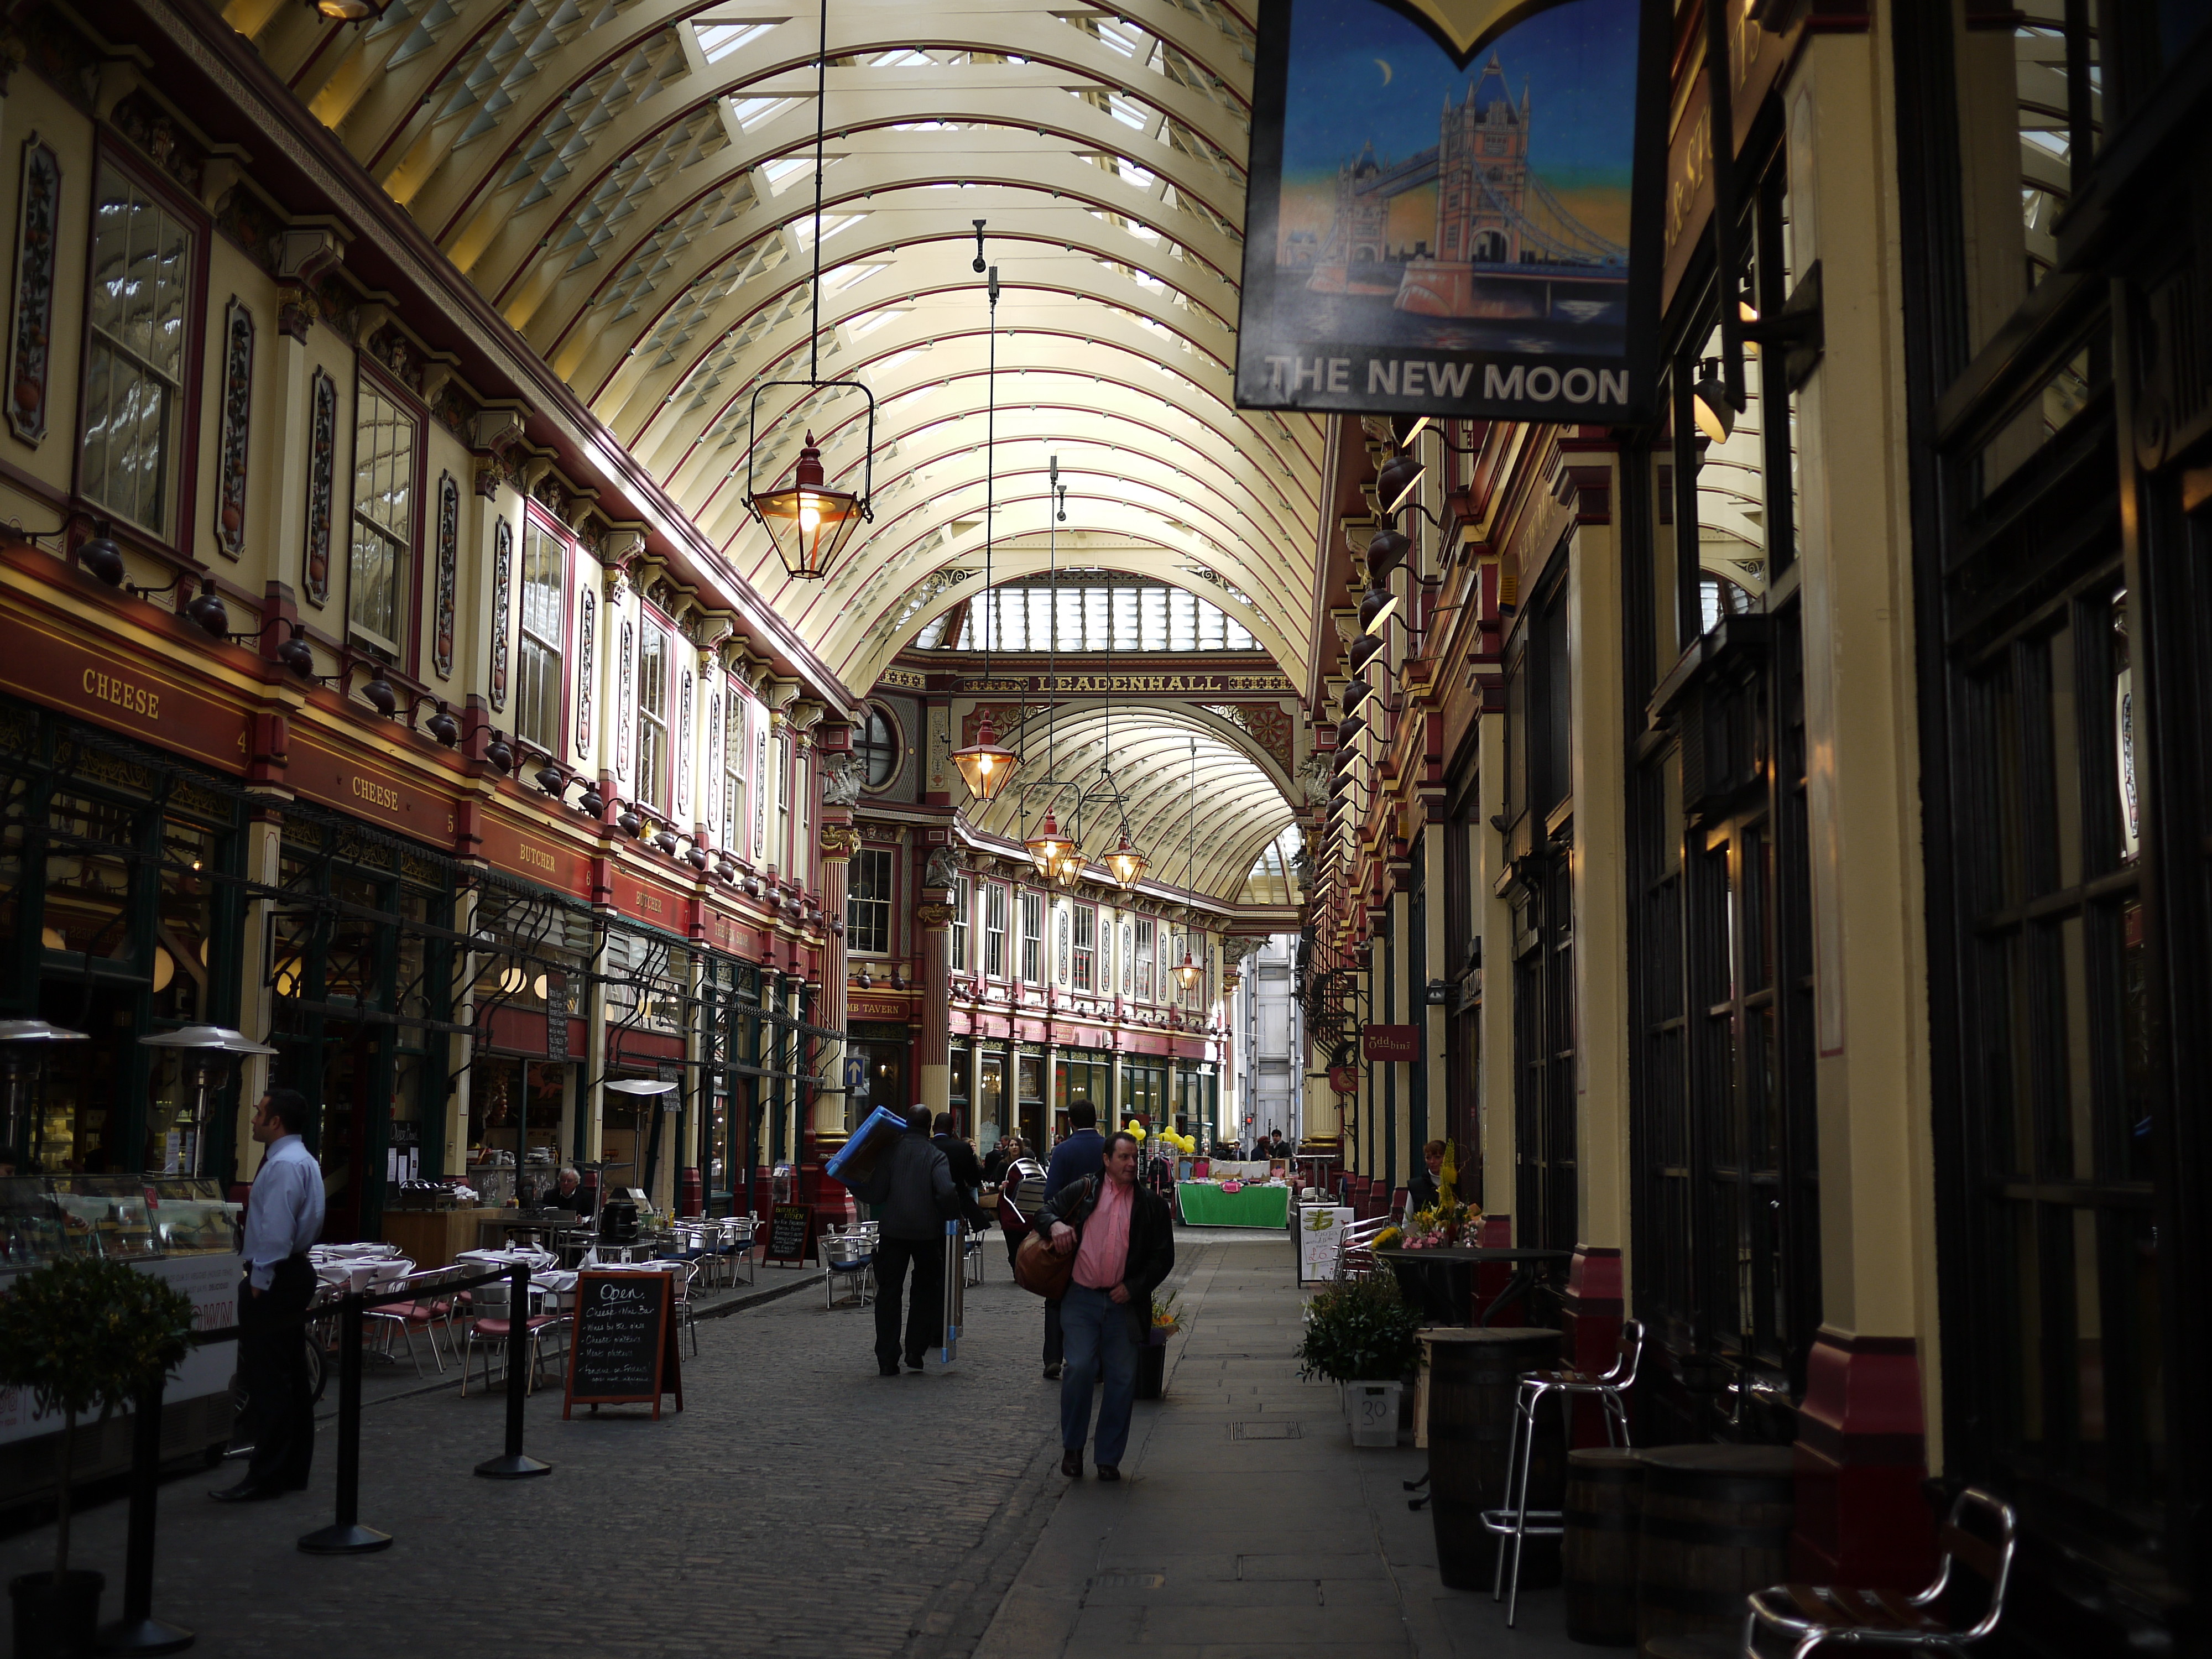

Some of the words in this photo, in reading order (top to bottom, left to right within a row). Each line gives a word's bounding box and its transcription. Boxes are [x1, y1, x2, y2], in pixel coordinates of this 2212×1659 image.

[1265, 355, 1350, 393] THE
[1367, 359, 1474, 398] NEW
[1484, 364, 1629, 405] MOON
[83, 668, 159, 719] CHEESE
[1037, 676, 1222, 691] LEADENHALL
[237, 731, 247, 754] 4
[353, 776, 399, 812] CHEESE
[448, 814, 454, 833] 5
[520, 843, 555, 873] BUTCHER
[586, 870, 591, 886] 6
[636, 890, 662, 913] BUTCHER
[684, 910, 688, 924] 7
[714, 922, 724, 938] THE
[736, 929, 749, 947] SHOP
[863, 1004, 899, 1014] TAVERN
[586, 1307, 618, 1318] Cheese
[638, 1305, 655, 1314] Bar
[606, 1322, 614, 1334] by
[629, 1322, 645, 1332] glass
[586, 1334, 612, 1345] Cheese
[1362, 1401, 1387, 1426] 30
